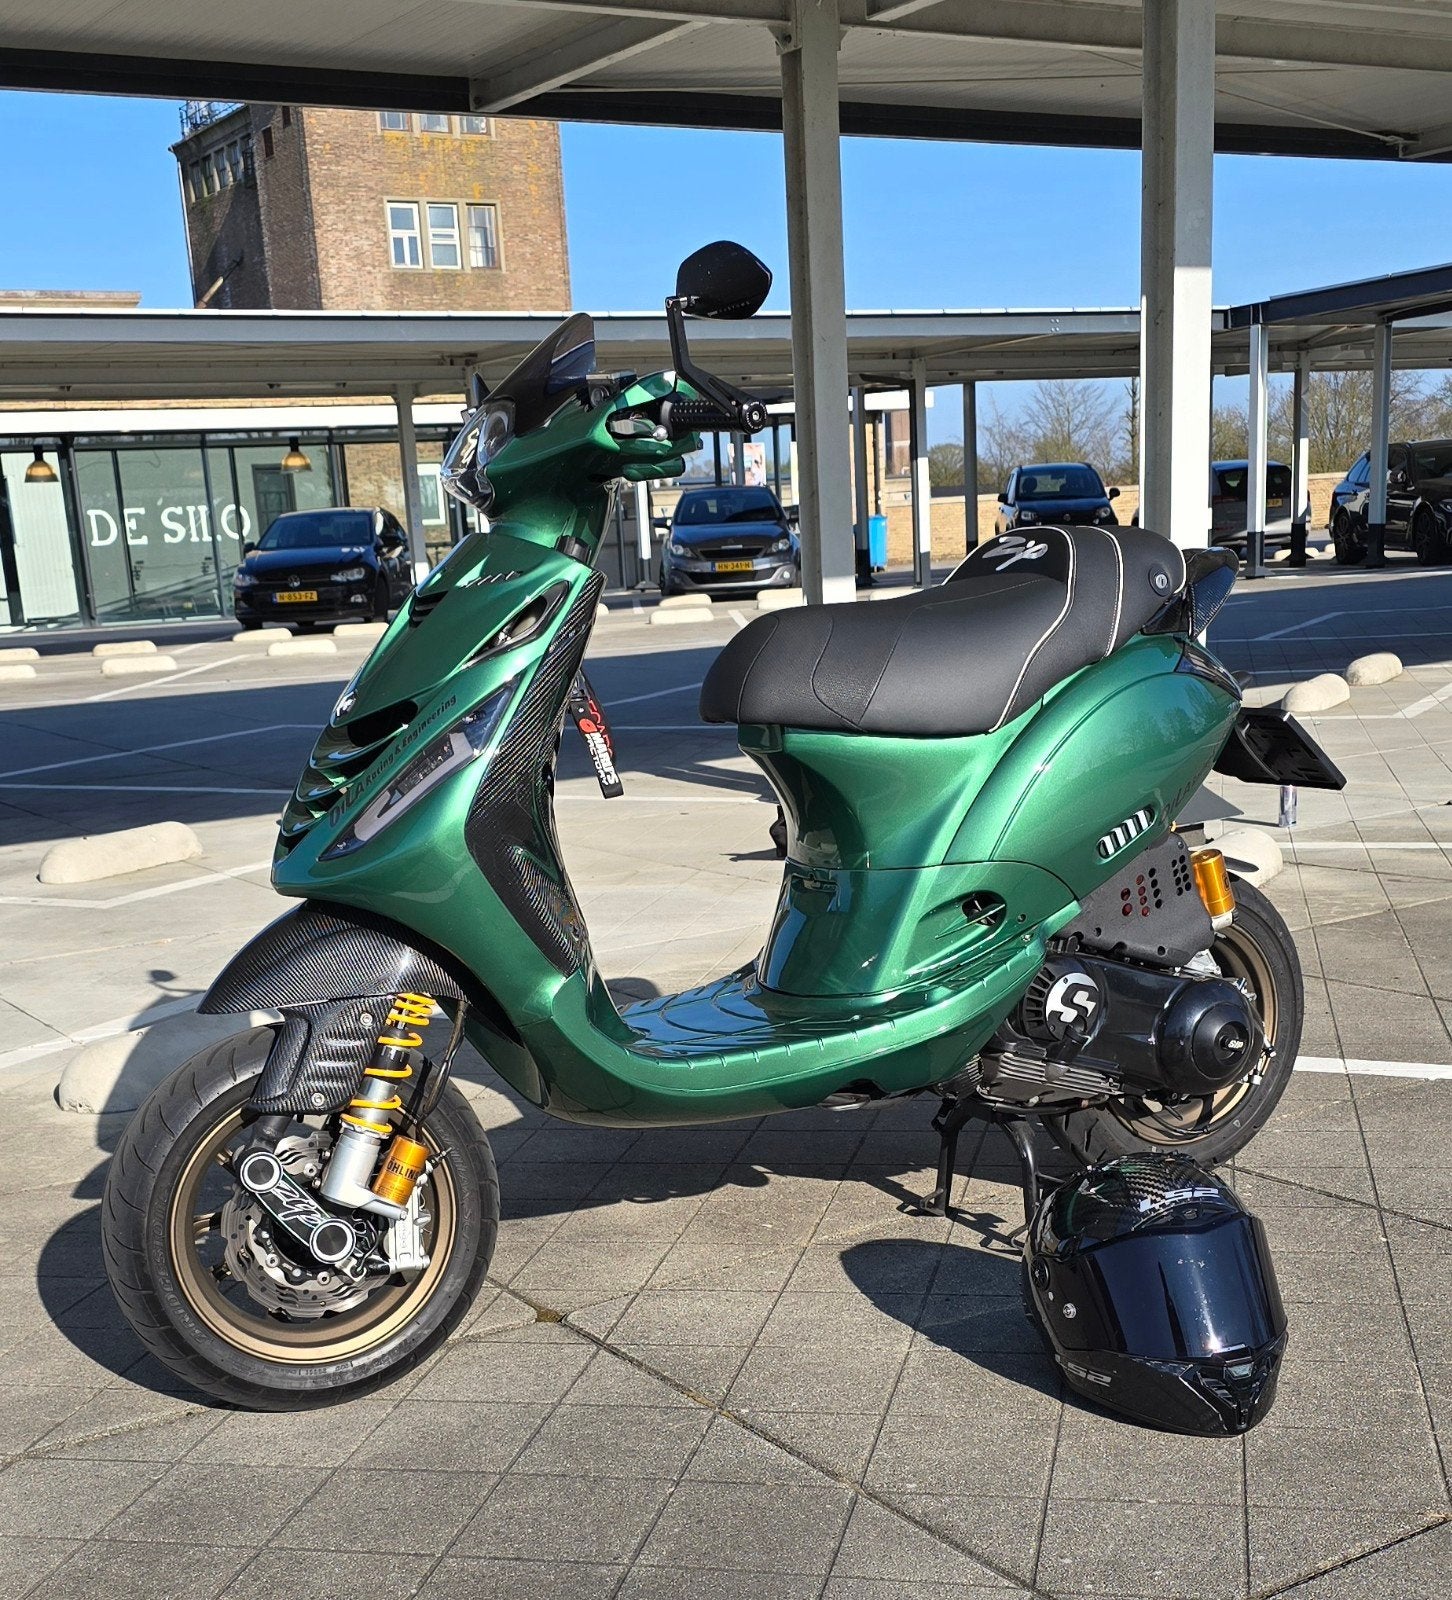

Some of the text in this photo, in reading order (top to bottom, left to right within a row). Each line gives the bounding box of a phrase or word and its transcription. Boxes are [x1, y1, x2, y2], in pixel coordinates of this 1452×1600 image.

[86, 503, 251, 547] DE SILO
[366, 756, 394, 787] Racing
[402, 694, 457, 748] Engineering
[584, 733, 609, 786] FACTORY
[1140, 1187, 1220, 1213] LS2
[1054, 1353, 1112, 1387] LS2
